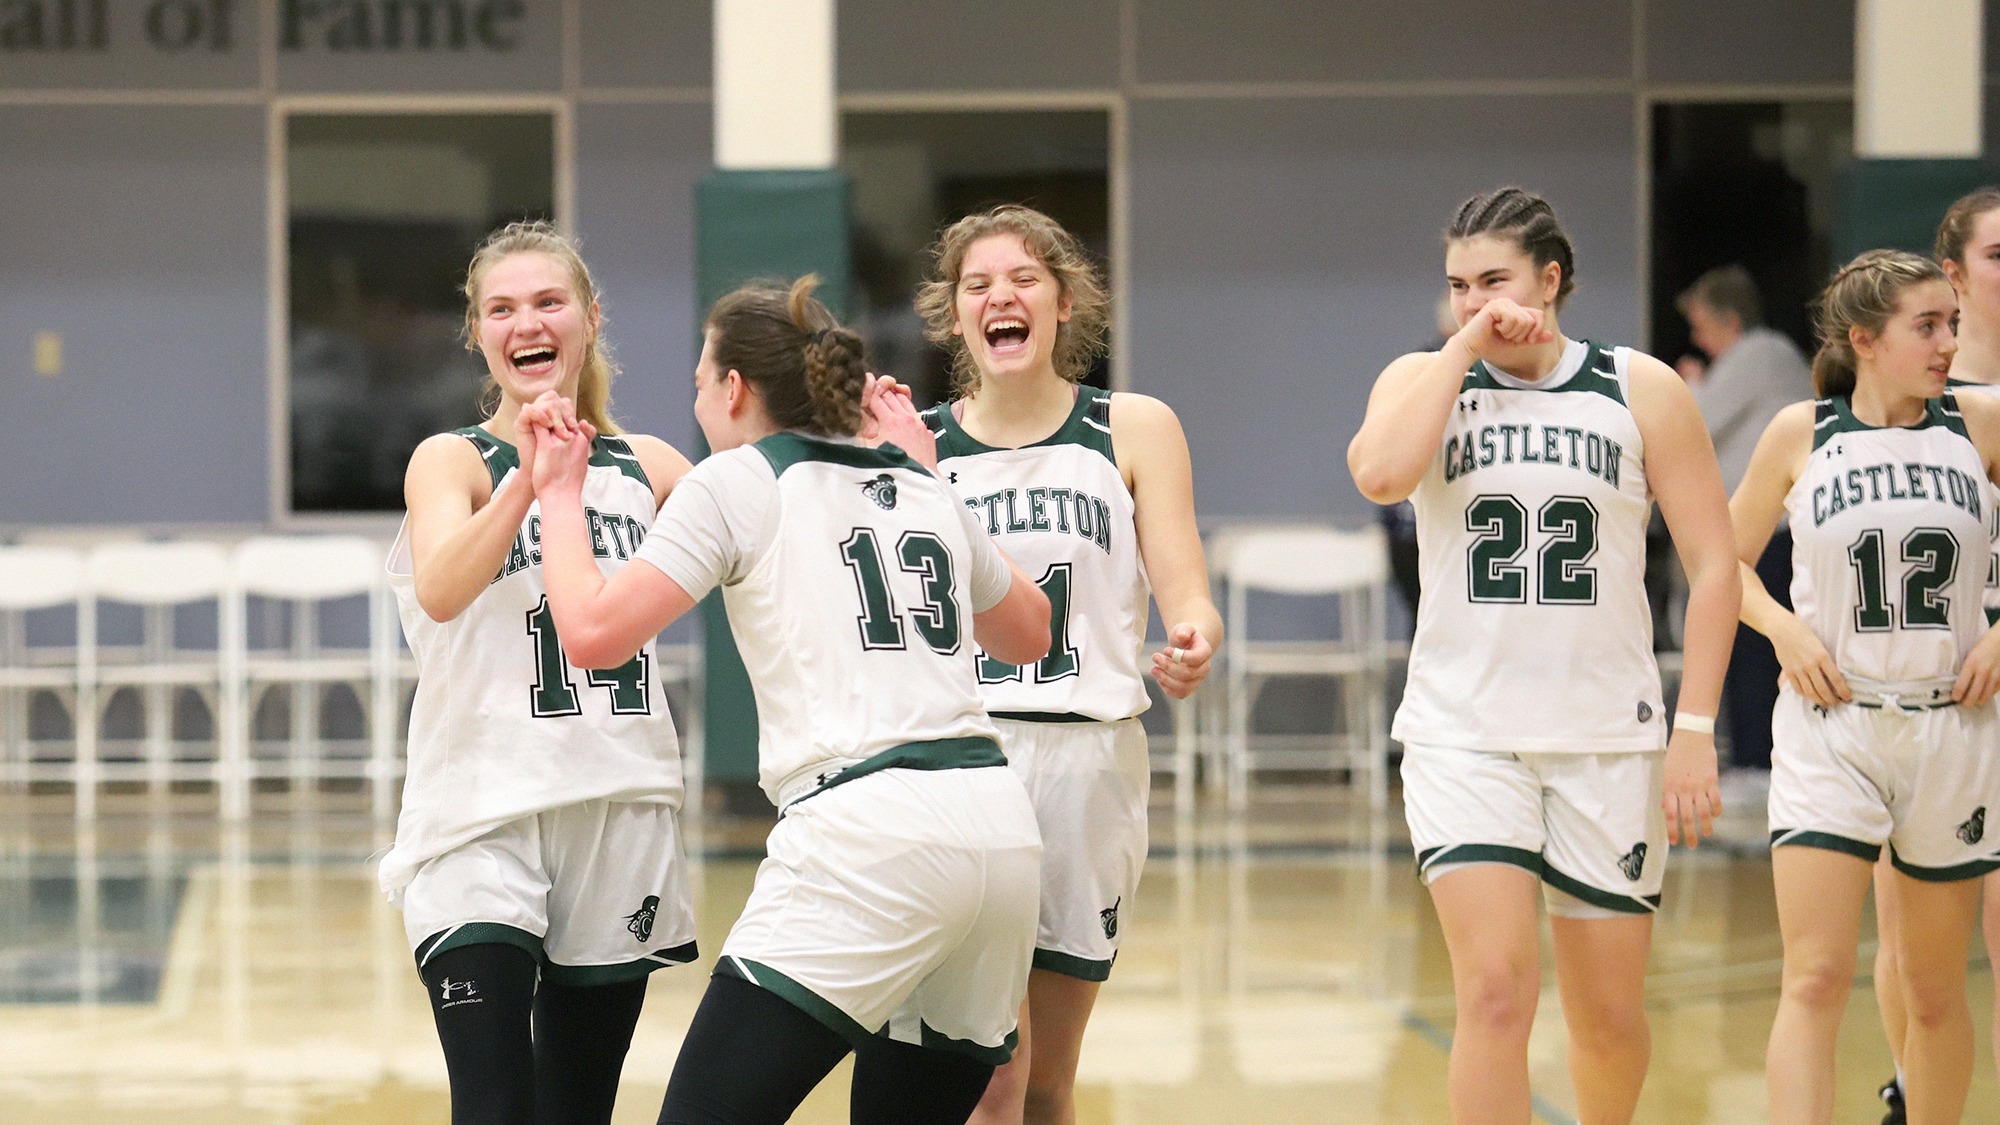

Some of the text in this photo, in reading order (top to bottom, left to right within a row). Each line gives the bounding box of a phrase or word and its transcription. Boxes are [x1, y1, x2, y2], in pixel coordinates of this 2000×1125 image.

[143, 0, 236, 49] of
[277, 0, 525, 49] Fame
[1444, 423, 1623, 491] CASTLETON
[963, 486, 1112, 556] TLETON
[1811, 462, 1982, 529] CASTLETON
[1465, 493, 1600, 606] 22
[1847, 526, 1961, 634] 12
[838, 526, 962, 657] 13
